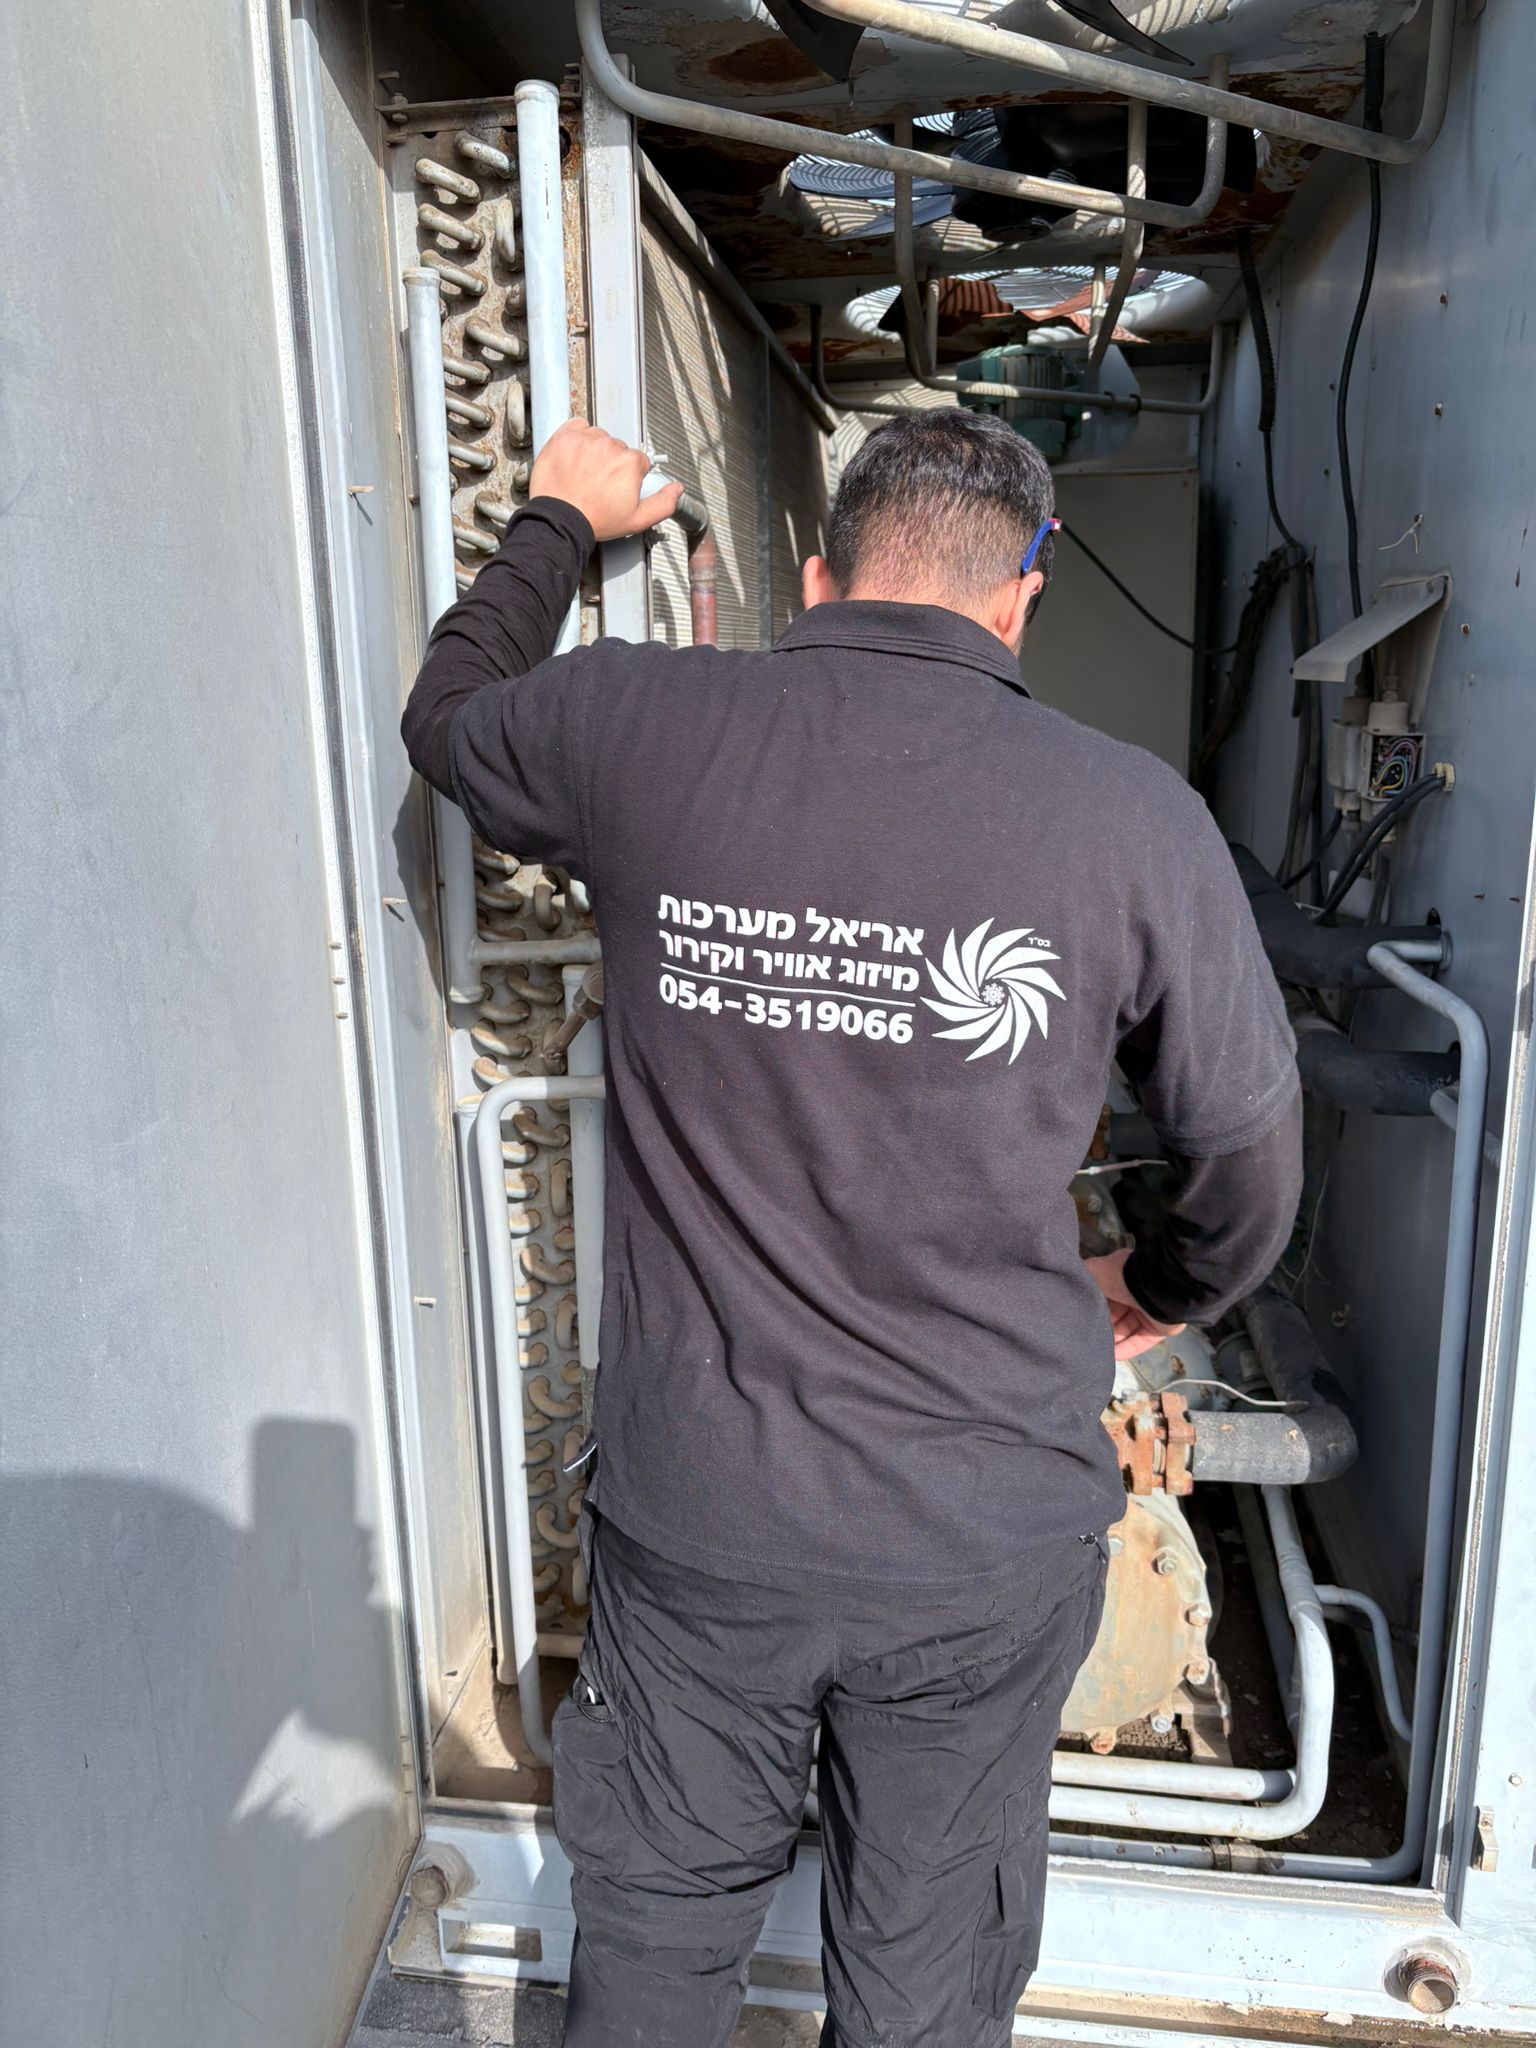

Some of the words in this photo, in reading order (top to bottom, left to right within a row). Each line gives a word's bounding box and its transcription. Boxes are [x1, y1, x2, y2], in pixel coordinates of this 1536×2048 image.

[658, 895, 797, 940] מערכות
[806, 907, 924, 955] אריאל
[658, 930, 745, 974] וקירור
[752, 949, 832, 980] אוויר
[838, 958, 920, 992] מיזוג
[659, 974, 914, 1044] 054-3519066
